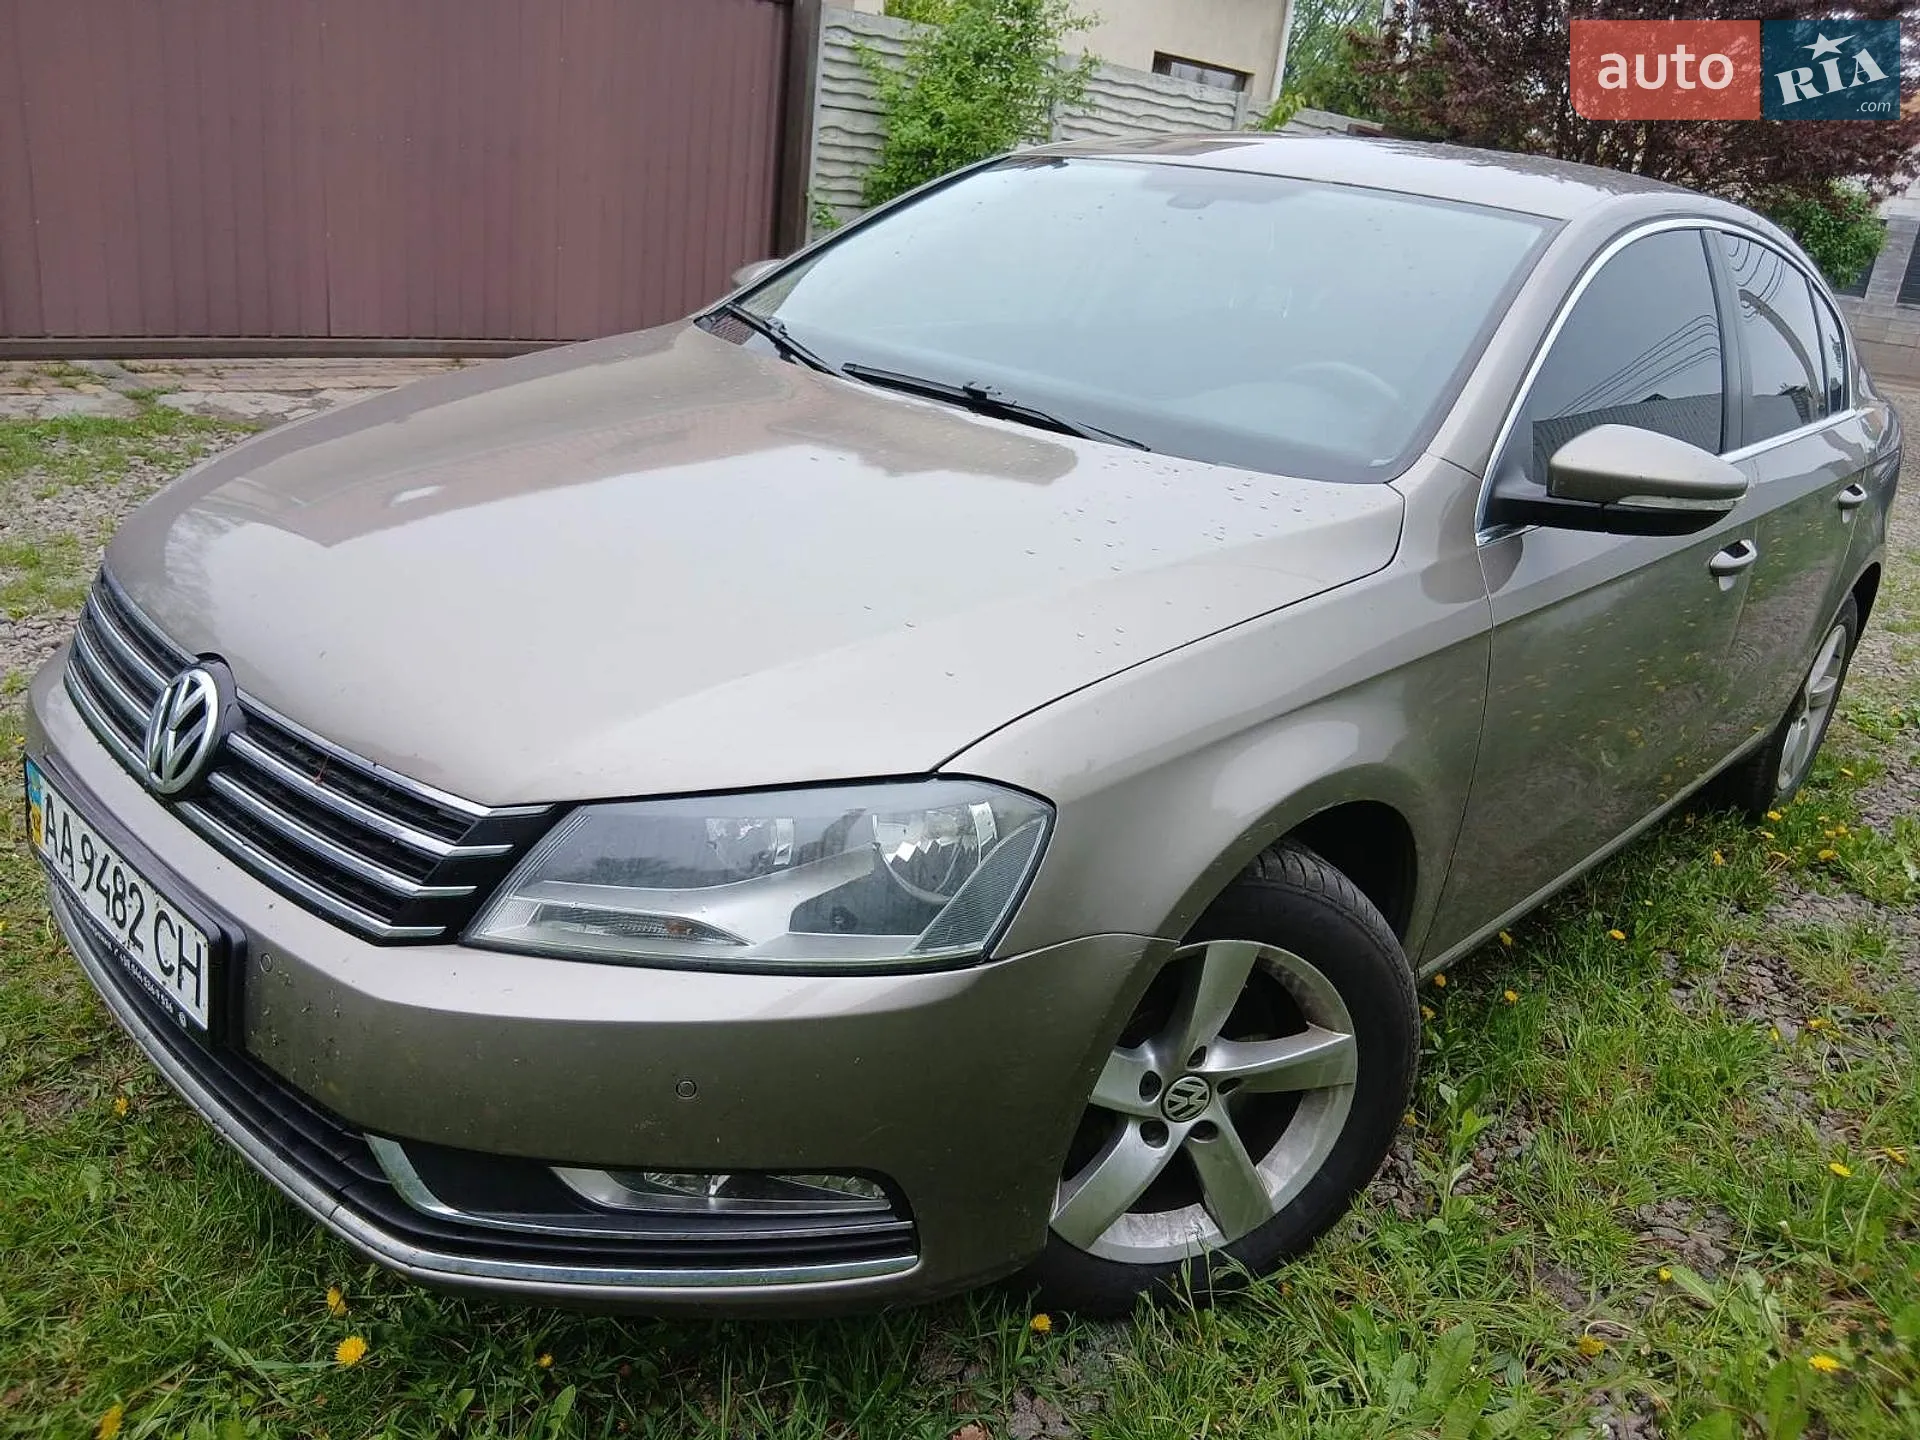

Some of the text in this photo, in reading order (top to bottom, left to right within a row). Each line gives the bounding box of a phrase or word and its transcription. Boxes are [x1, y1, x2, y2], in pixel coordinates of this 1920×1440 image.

[45, 793, 75, 882] AA
[80, 833, 145, 953] 9482
[153, 910, 202, 1008] CH
